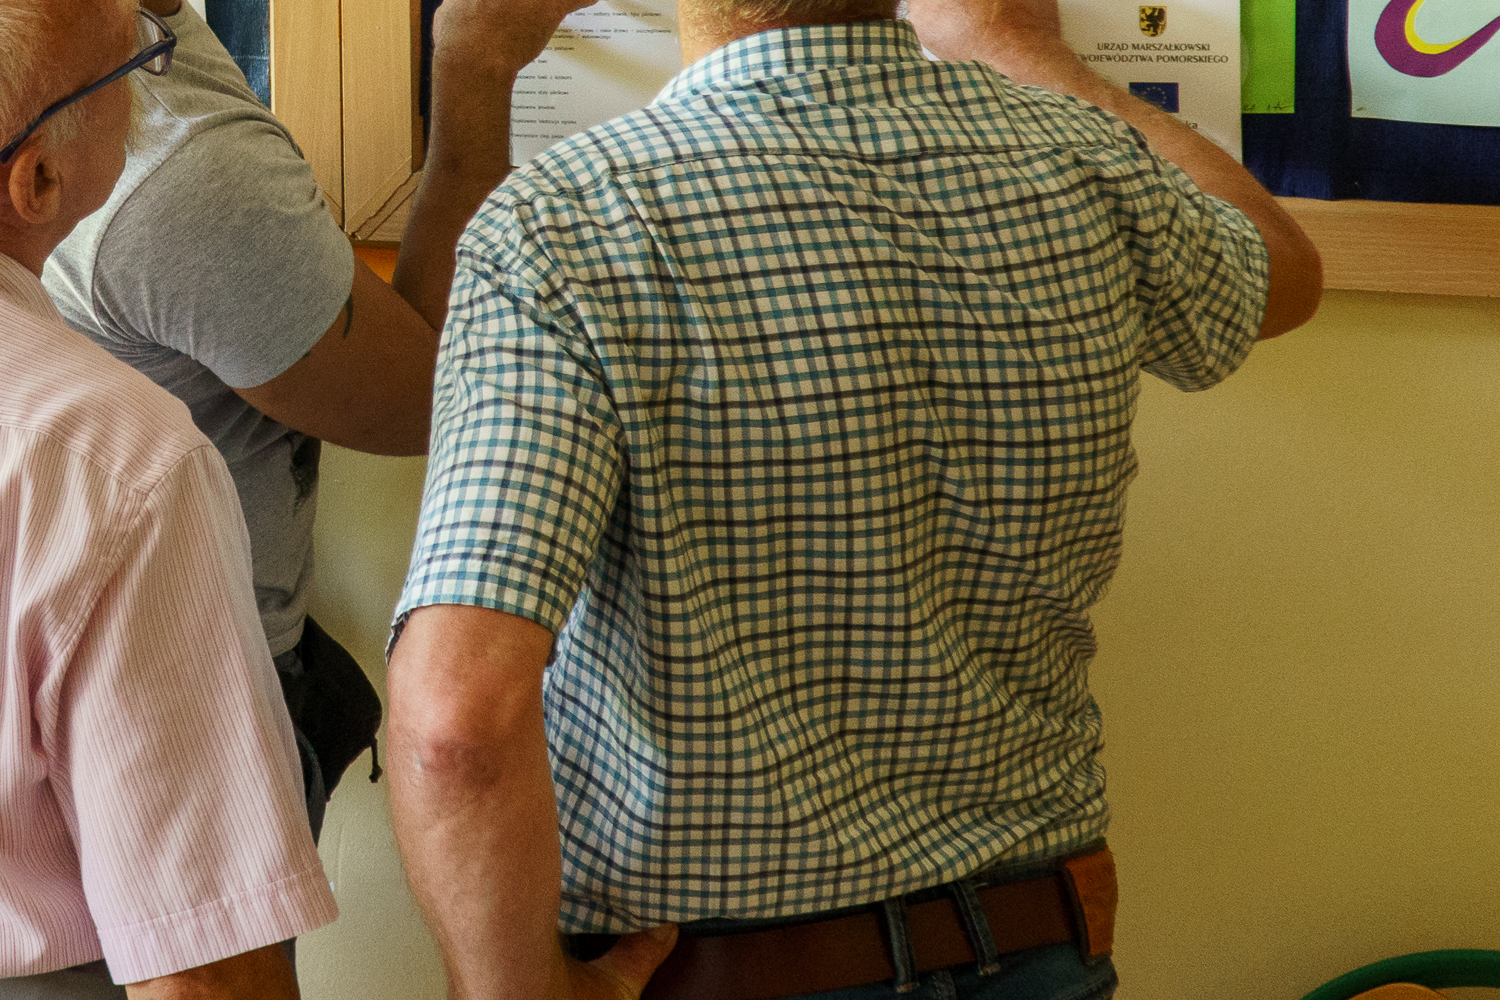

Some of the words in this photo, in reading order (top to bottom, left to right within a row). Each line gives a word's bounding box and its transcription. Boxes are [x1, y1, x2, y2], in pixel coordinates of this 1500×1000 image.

[1097, 42, 1129, 53] URZĄD
[1131, 42, 1210, 51] MARSZAŁKOWSKI
[1156, 53, 1229, 64] POMORSKIEGO
